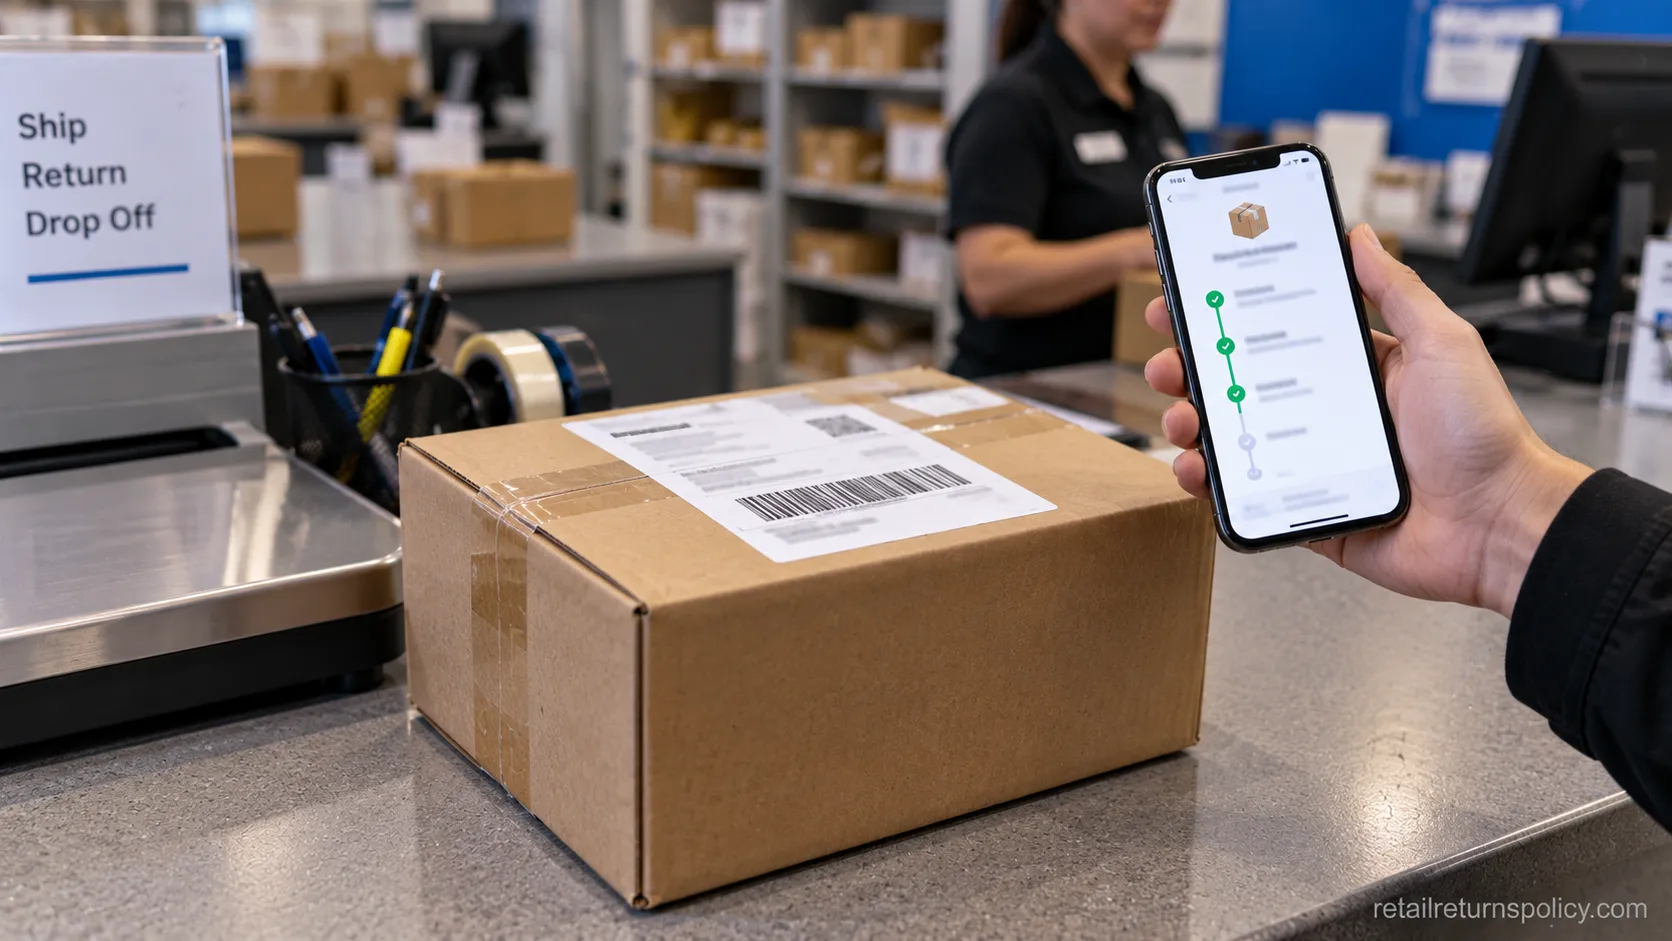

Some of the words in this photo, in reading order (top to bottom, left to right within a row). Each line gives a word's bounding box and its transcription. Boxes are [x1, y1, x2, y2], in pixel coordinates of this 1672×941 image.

[18, 112, 87, 145] Ship
[22, 162, 127, 189] Return
[26, 210, 101, 240] Drop
[109, 203, 155, 231] Off
